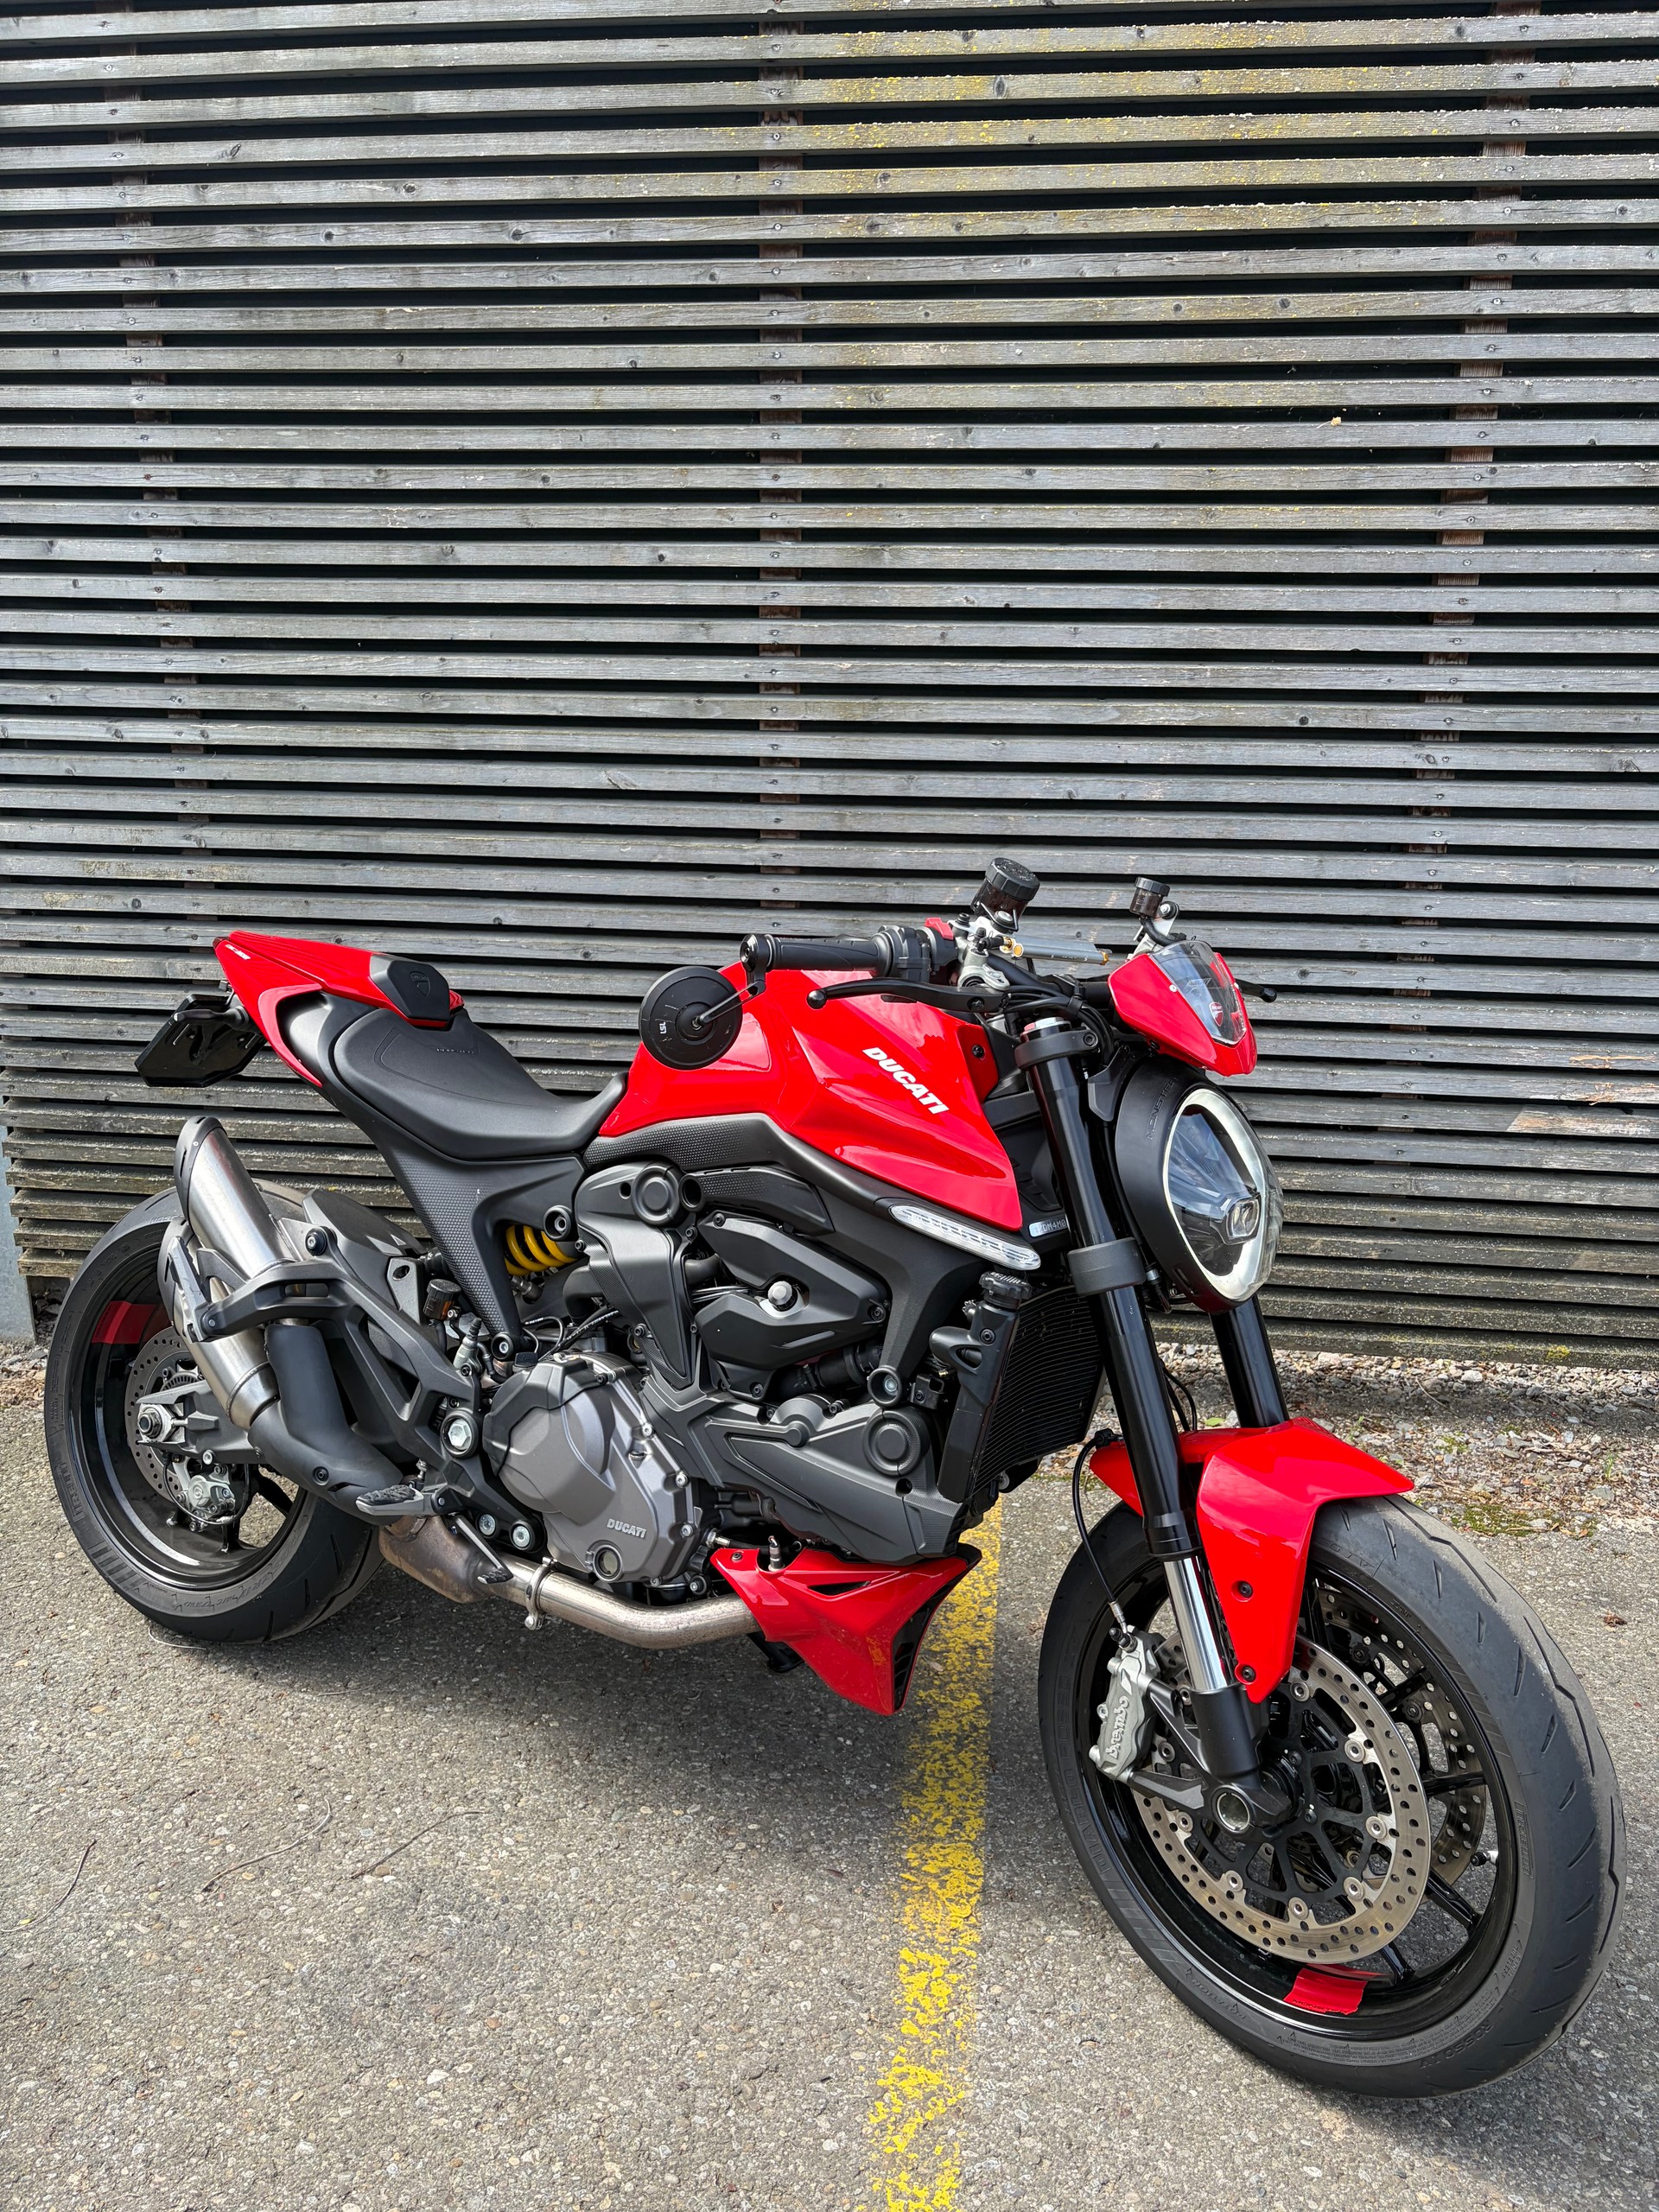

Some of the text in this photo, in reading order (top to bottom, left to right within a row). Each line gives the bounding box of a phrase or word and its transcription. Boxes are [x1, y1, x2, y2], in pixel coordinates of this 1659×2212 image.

[861, 1046, 950, 1115] DUCATI
[1145, 1077, 1179, 1141] MONSTER
[606, 1517, 647, 1539] DUCATI
[1057, 1675, 1073, 1759] ROSSO
[1104, 1694, 1129, 1759] brembo
[1064, 1765, 1112, 1876] DIABLO
